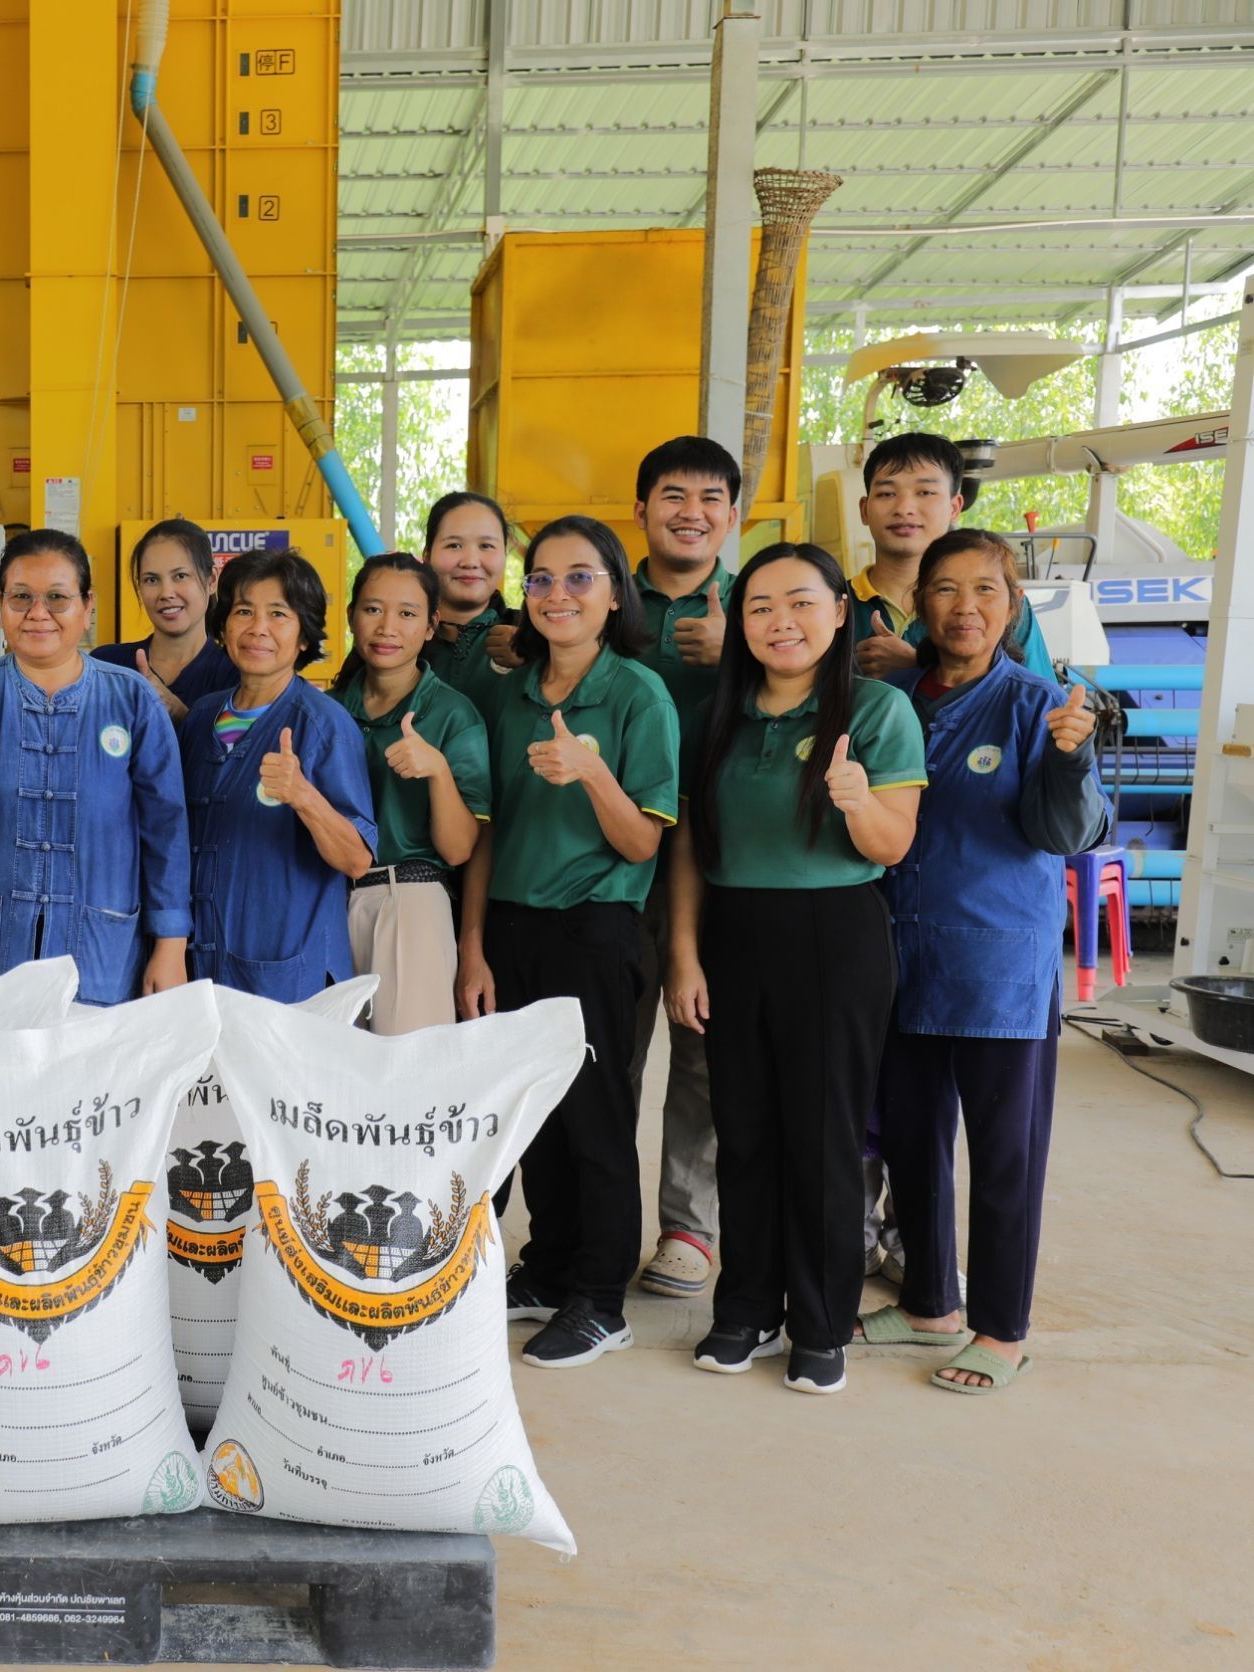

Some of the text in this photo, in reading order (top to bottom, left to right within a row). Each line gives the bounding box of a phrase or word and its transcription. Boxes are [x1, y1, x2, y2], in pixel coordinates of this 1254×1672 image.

[265, 113, 278, 132] 3
[263, 200, 276, 217] 2
[1194, 427, 1229, 446] ISE
[207, 532, 267, 552] UNCUE
[1090, 576, 1215, 605] SEK
[269, 1097, 500, 1157] เมล็ดพันธุ์ข้าว
[92, 1434, 123, 1455] จังหวัด
[317, 1445, 347, 1464] อำเภอ
[422, 1447, 455, 1467] จังหวัด
[282, 1457, 328, 1491] วันที่บรรจุ
